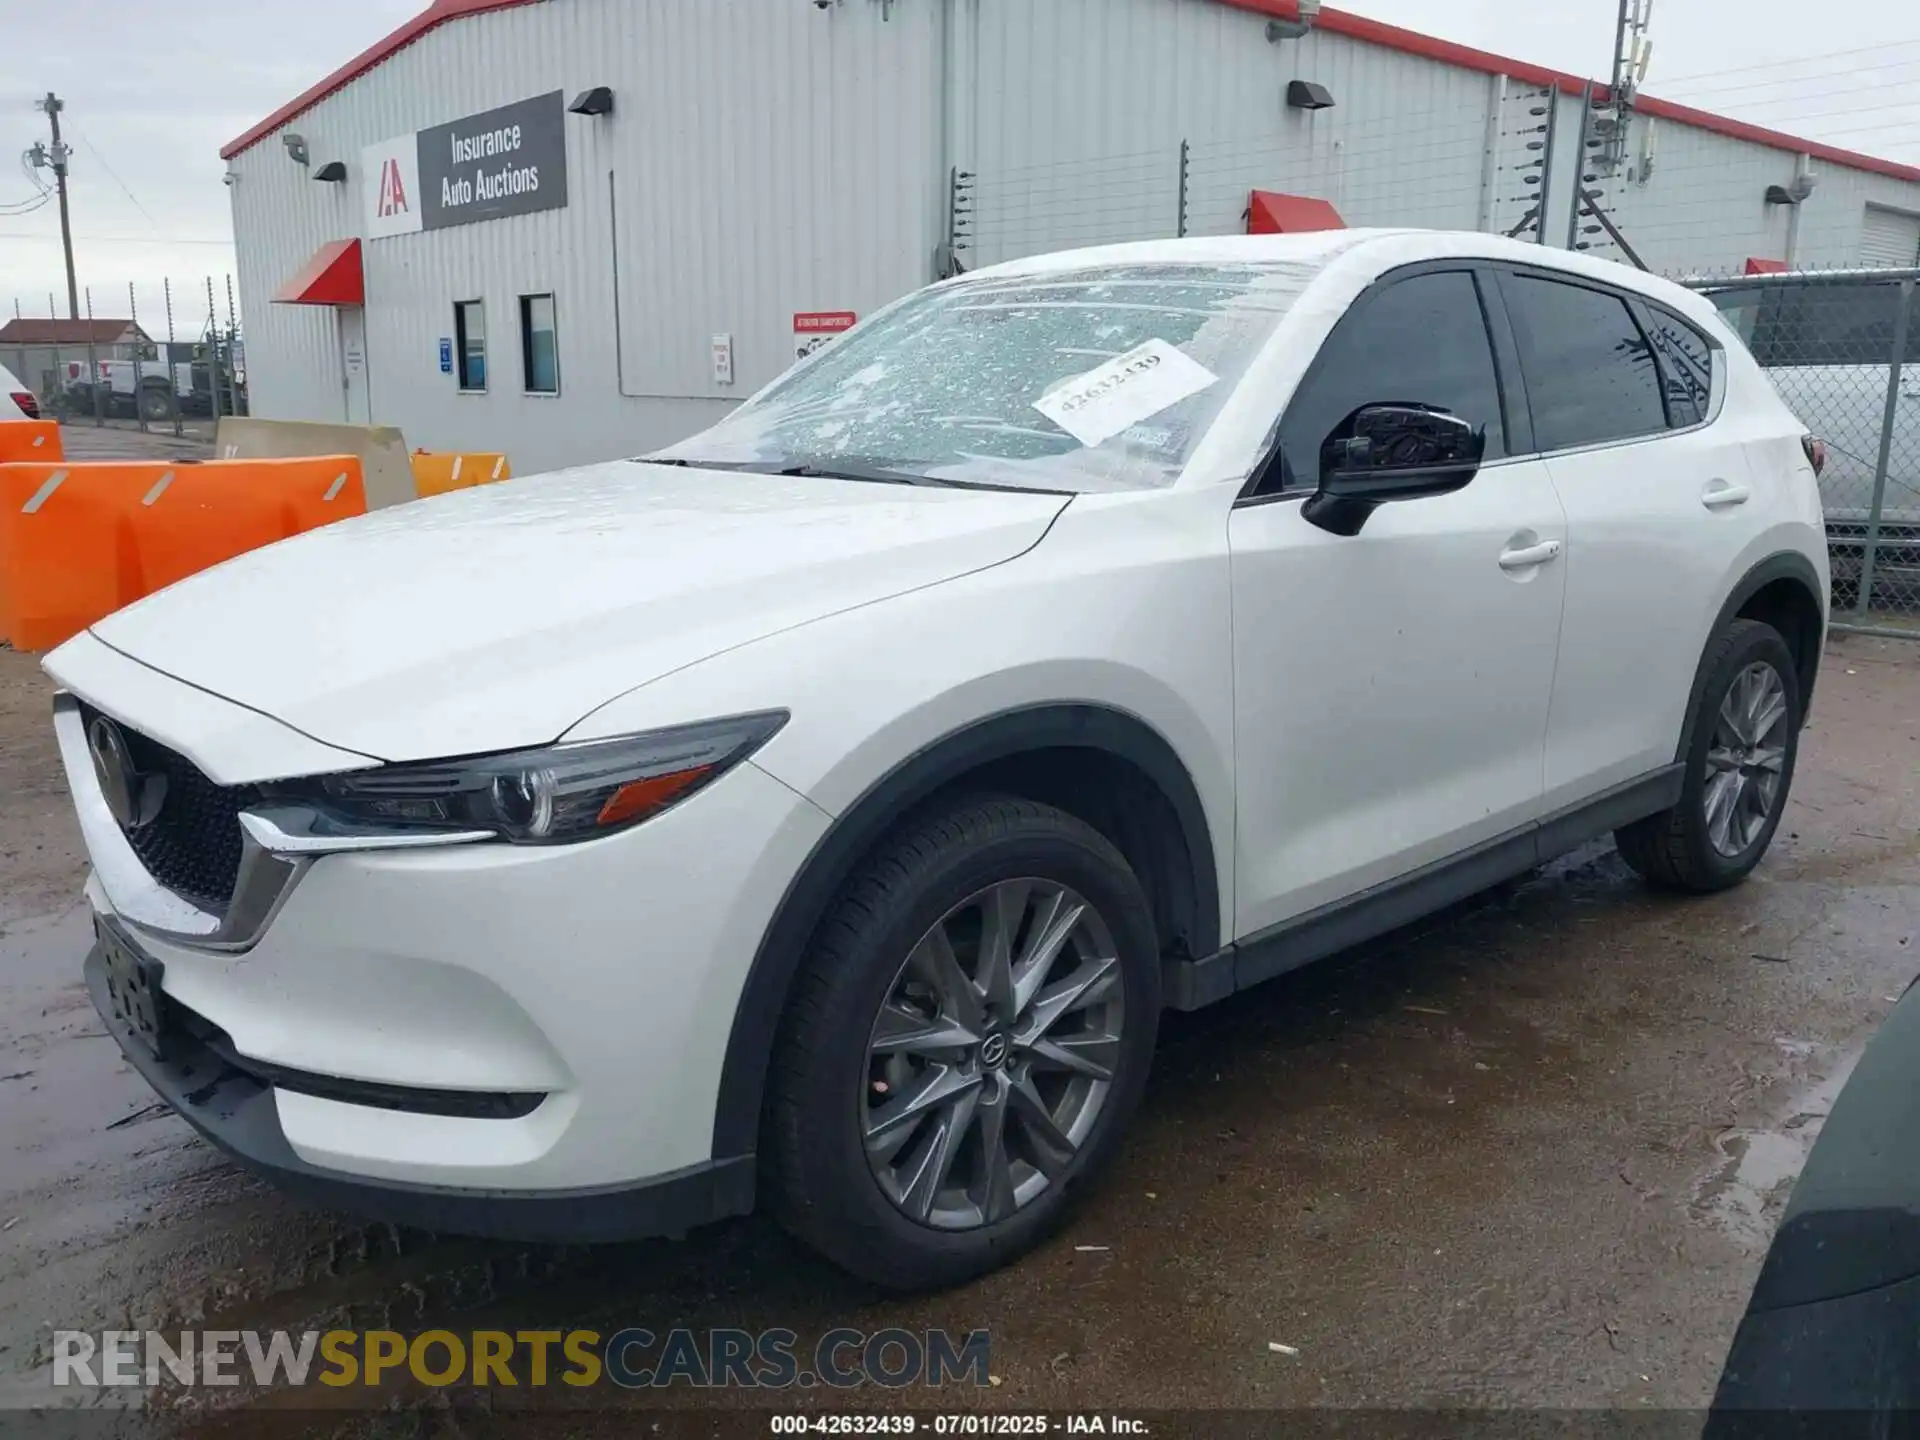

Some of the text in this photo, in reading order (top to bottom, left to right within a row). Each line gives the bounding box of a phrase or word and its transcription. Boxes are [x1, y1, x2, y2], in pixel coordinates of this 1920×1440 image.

[451, 125, 521, 164] Insurance
[441, 162, 539, 208] Auto Auctions
